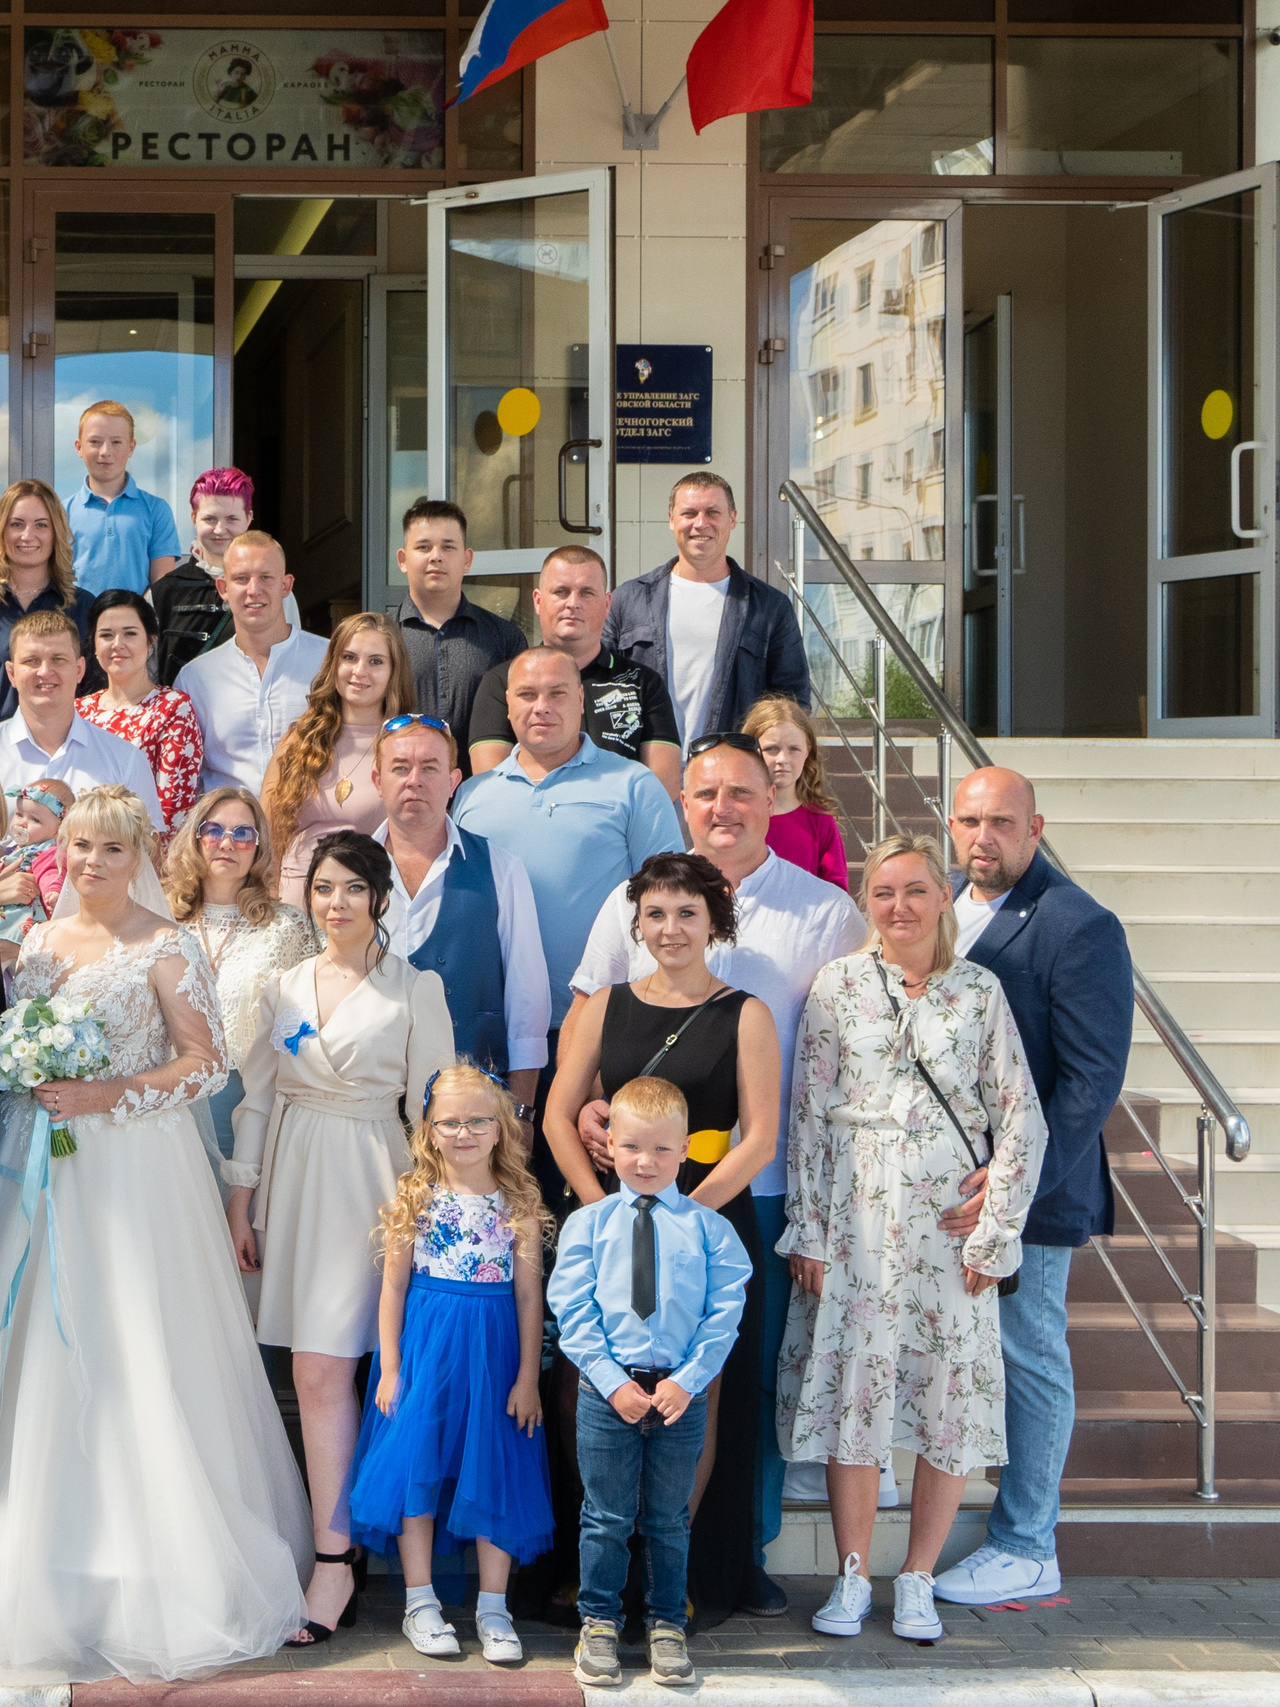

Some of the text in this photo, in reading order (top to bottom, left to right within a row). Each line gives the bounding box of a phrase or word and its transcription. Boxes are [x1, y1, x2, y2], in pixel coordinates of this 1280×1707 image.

[208, 44, 260, 62] MAMMA
[138, 80, 186, 88] РЕСТОРАН
[209, 105, 261, 121] ITALIA
[111, 131, 351, 162] РЕСТОРАН
[623, 392, 678, 400] УПРАВЛЕНИЕ
[679, 392, 700, 400] ЗАГС
[616, 399, 692, 408] ОВСКОЙ ОБЛАСТИ
[616, 416, 694, 427] ЕЧНОГОРСКИЙ
[646, 428, 672, 437] ЗАГС
